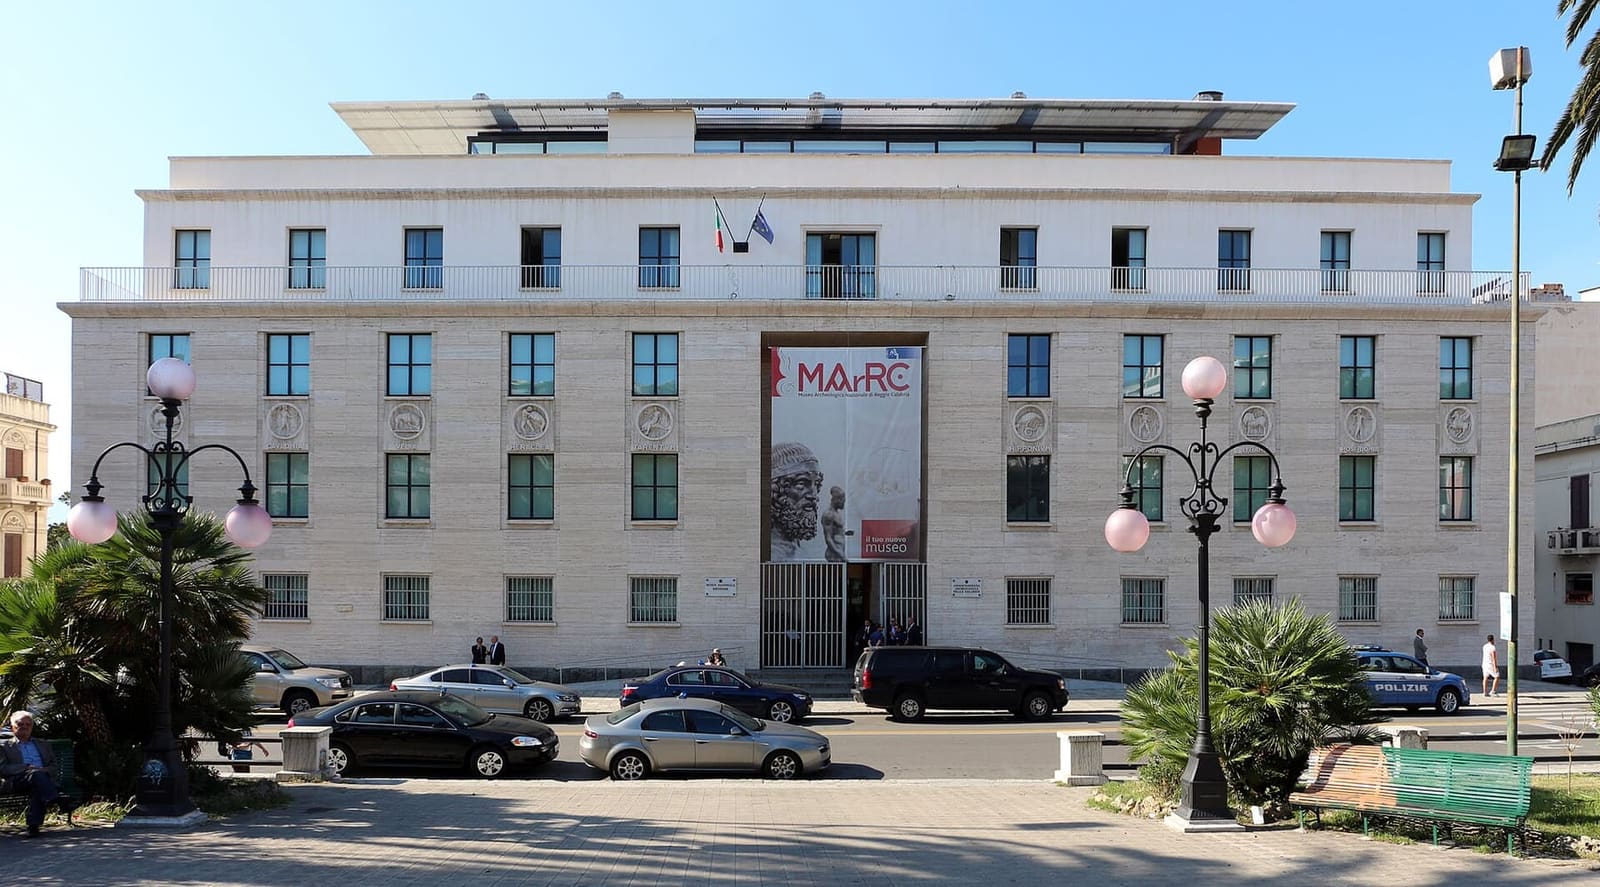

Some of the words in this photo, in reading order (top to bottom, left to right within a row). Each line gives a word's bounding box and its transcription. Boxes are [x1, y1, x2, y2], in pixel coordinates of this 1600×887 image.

[798, 362, 910, 392] MArRC
[865, 543, 907, 552] museo
[1375, 683, 1429, 692] POLIZIA
